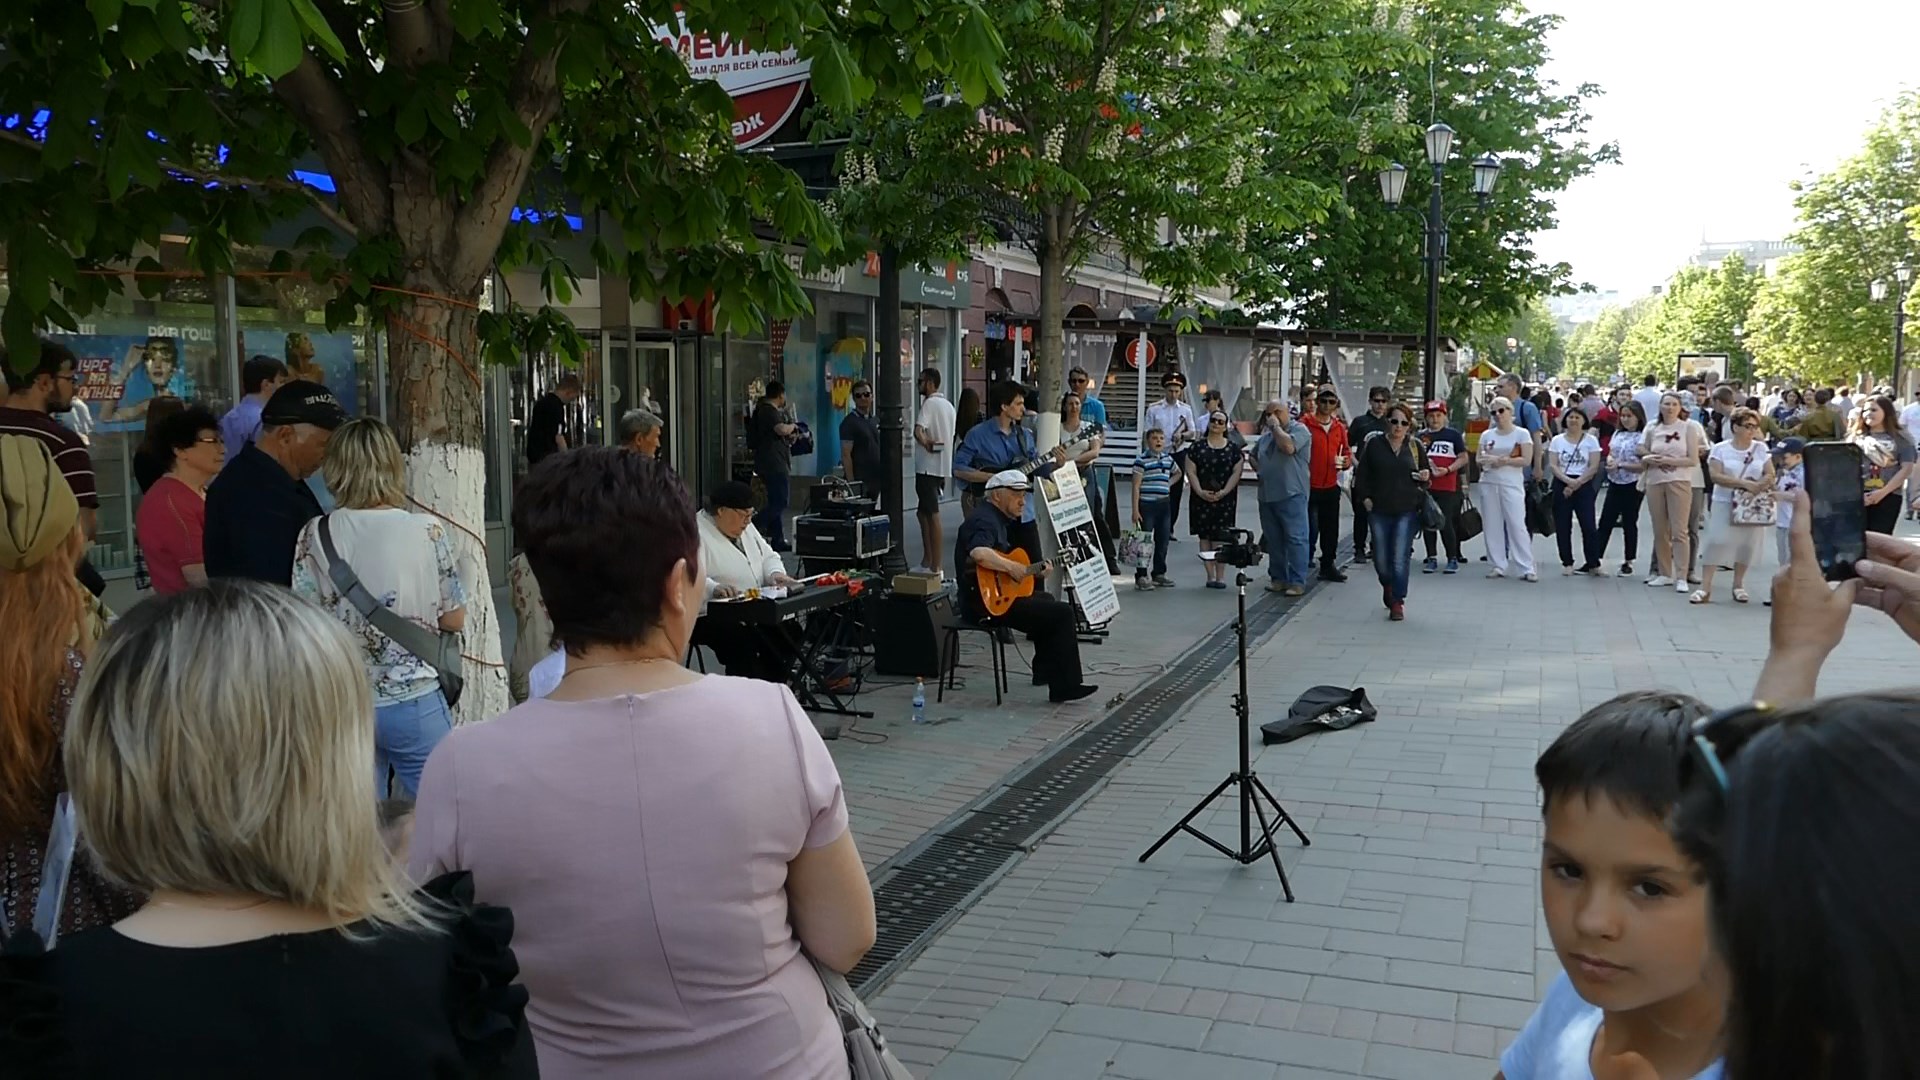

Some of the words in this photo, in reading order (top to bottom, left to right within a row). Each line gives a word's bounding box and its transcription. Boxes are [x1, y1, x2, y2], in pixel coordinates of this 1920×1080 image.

[709, 64, 730, 74] ДЛЯ
[733, 60, 759, 71] ВСЕЙ
[761, 57, 797, 69] СЕМЬИ
[731, 111, 766, 137] аж
[78, 385, 123, 399] ОЛНЦЕ
